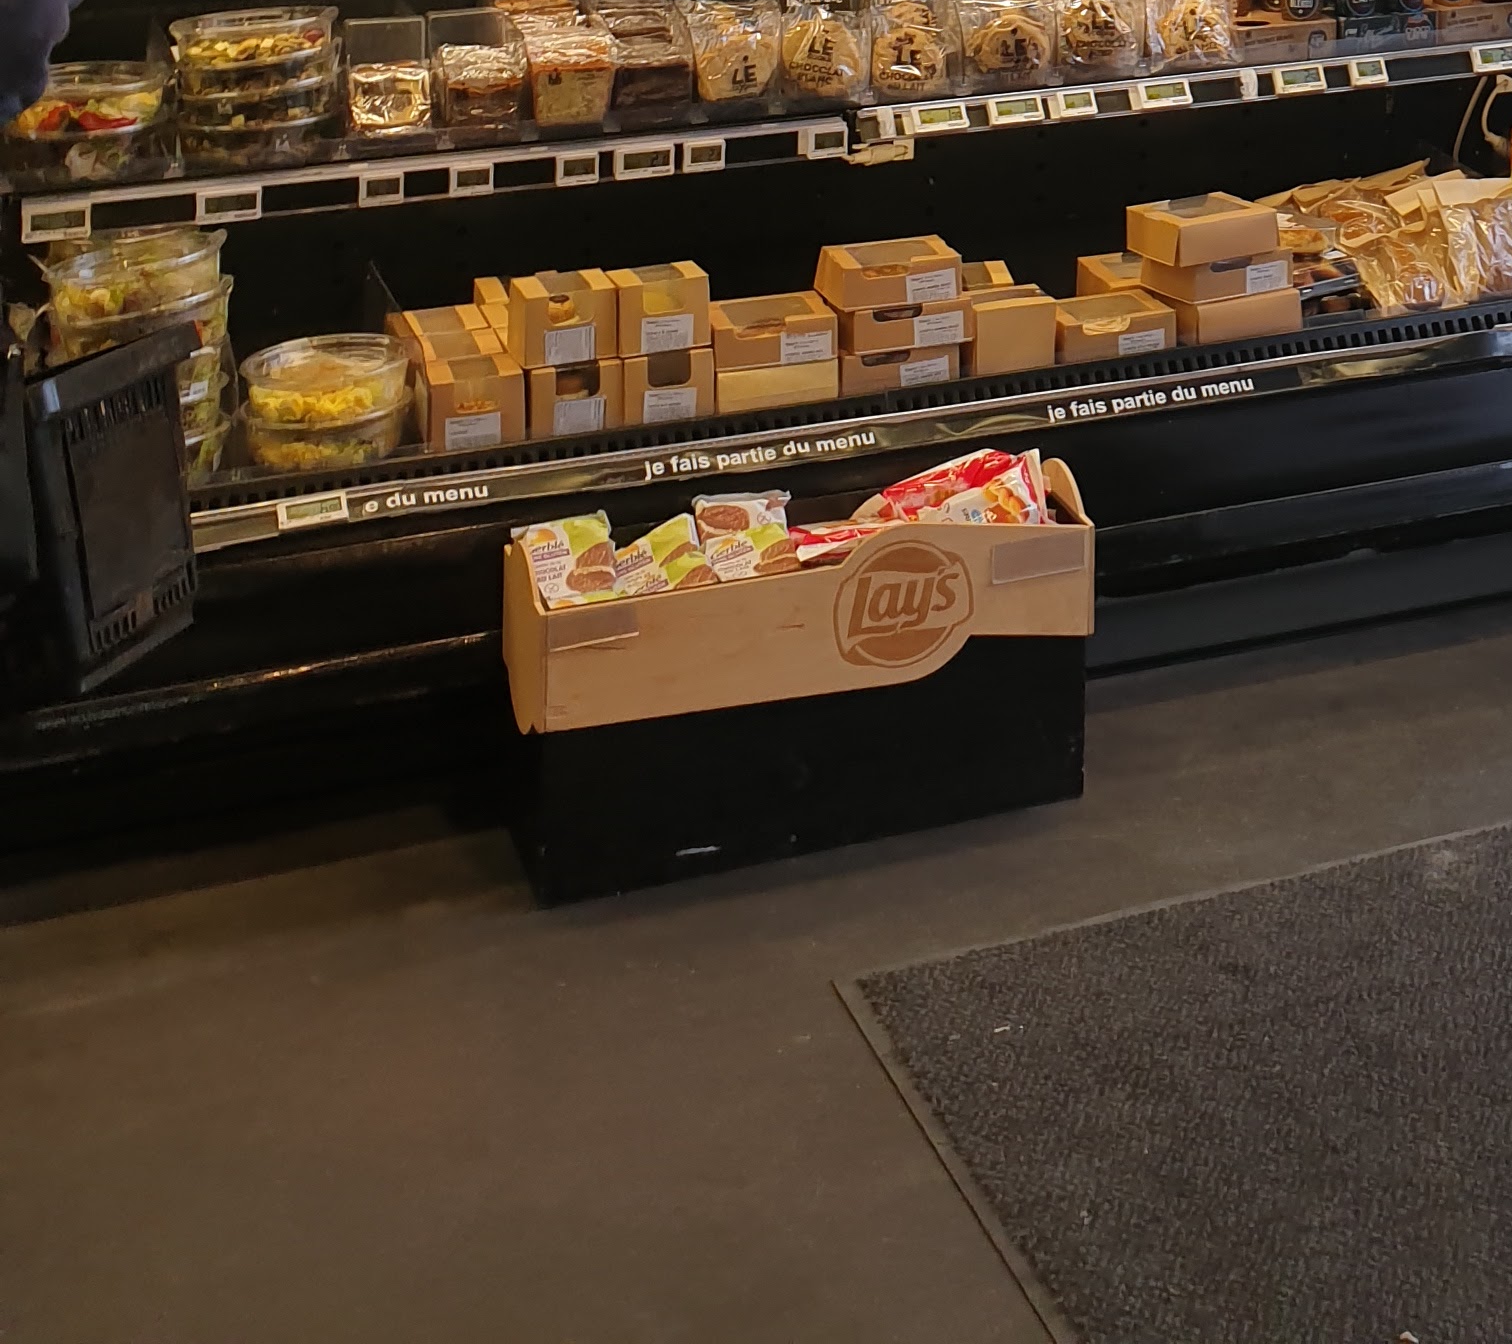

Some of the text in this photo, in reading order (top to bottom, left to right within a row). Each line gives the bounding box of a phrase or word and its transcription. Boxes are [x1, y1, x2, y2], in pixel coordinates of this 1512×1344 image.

[1046, 377, 1255, 423] je fais partie du menu
[643, 429, 876, 480] je fais partie du menu
[386, 489, 418, 510] du
[423, 483, 489, 503] menu
